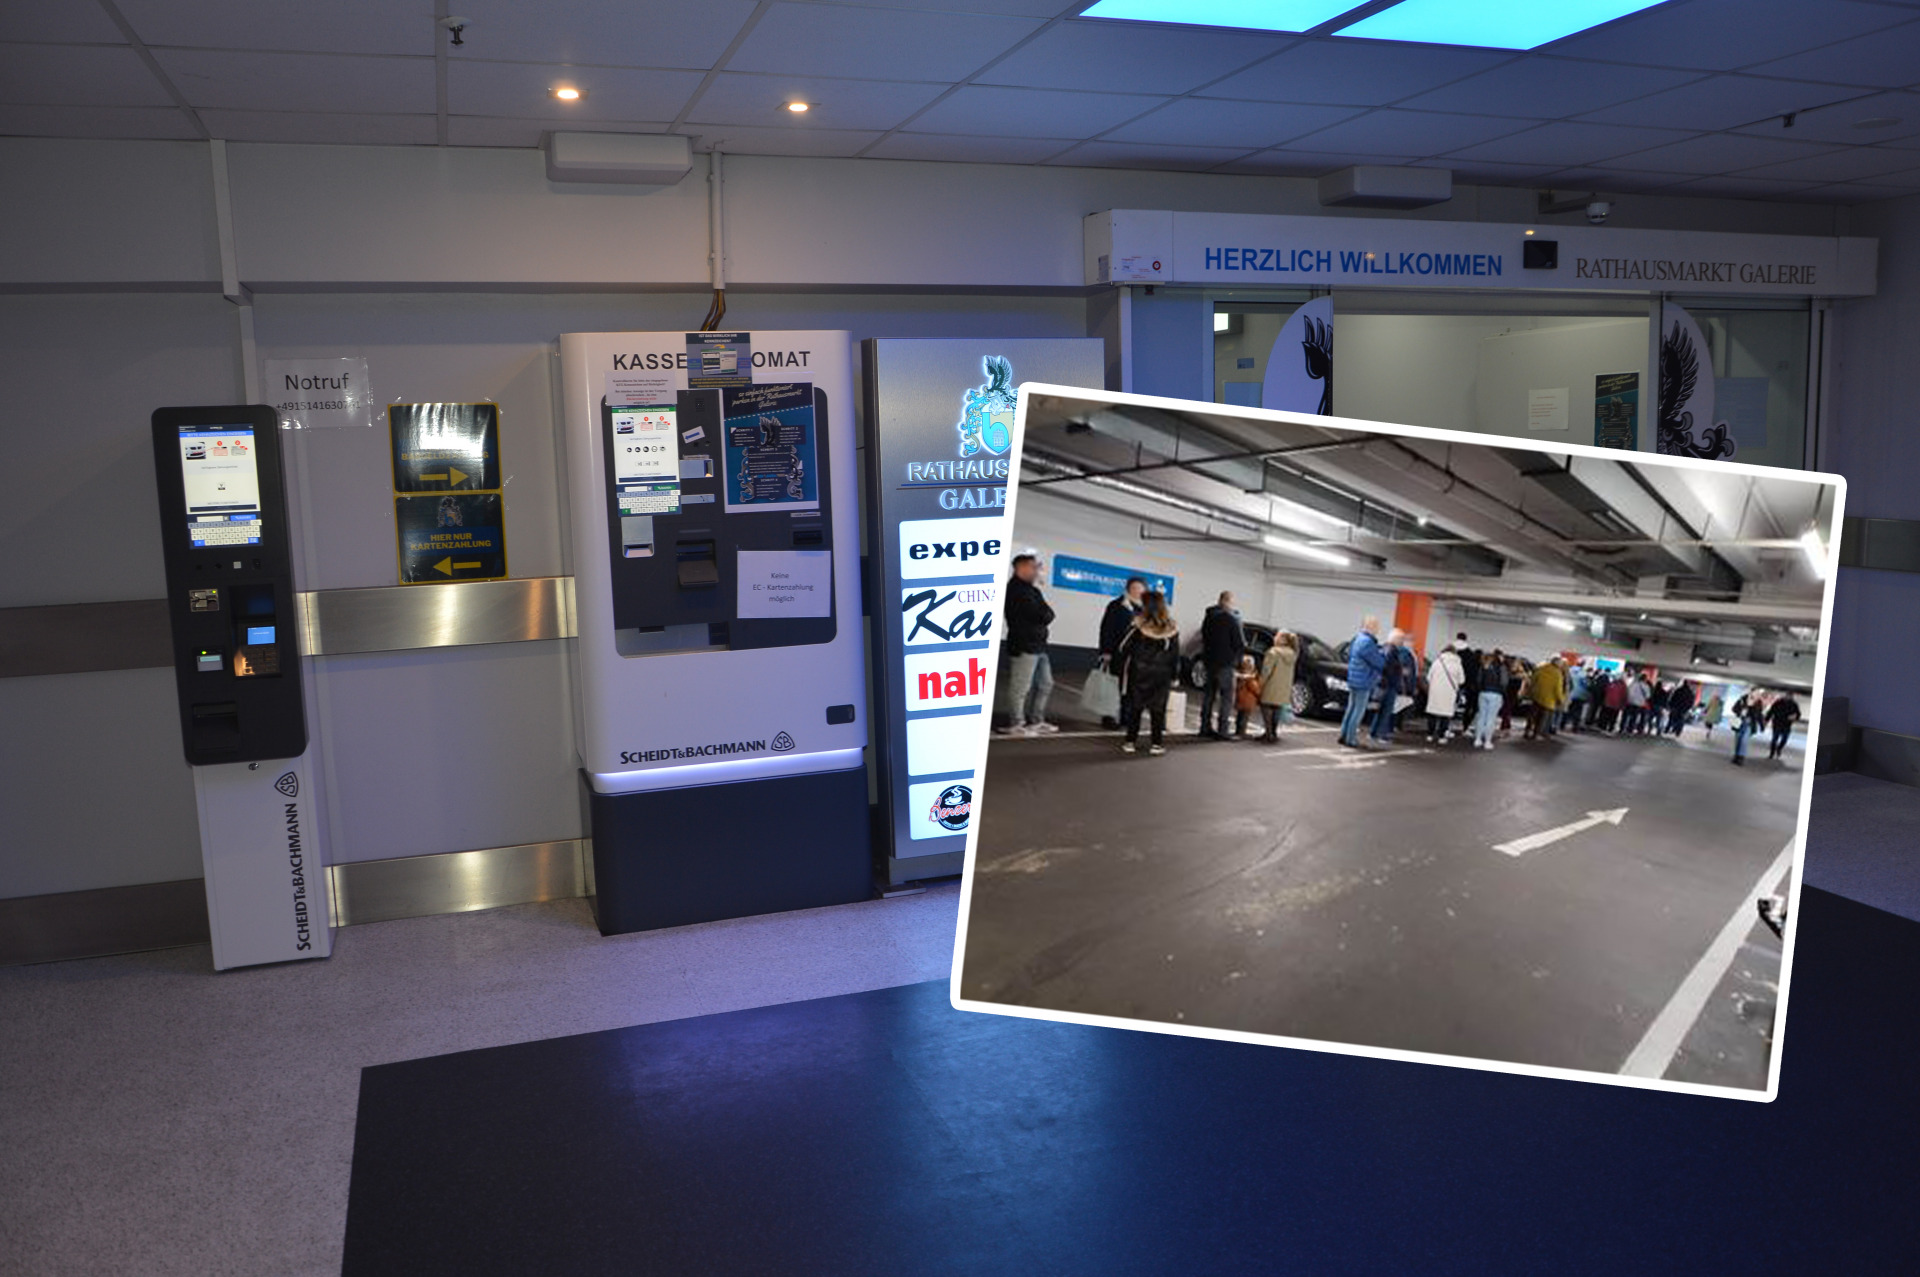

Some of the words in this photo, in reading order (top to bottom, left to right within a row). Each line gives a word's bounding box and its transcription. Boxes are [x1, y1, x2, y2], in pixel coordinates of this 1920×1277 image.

[1205, 247, 1332, 273] HERZLICH
[1339, 251, 1503, 277] WILLKOMMEN
[1575, 257, 1736, 283] RATHAUSMARKT
[1739, 263, 1817, 285] GALERIE
[285, 372, 349, 391] Notruf
[430, 534, 452, 542] HIER
[453, 532, 472, 540] NUR
[410, 538, 492, 551] KARTENZAHLUNG
[909, 539, 1001, 561] expe
[770, 572, 790, 580] Keine
[766, 583, 814, 592] Kartenzahlung
[768, 594, 795, 603] möglich
